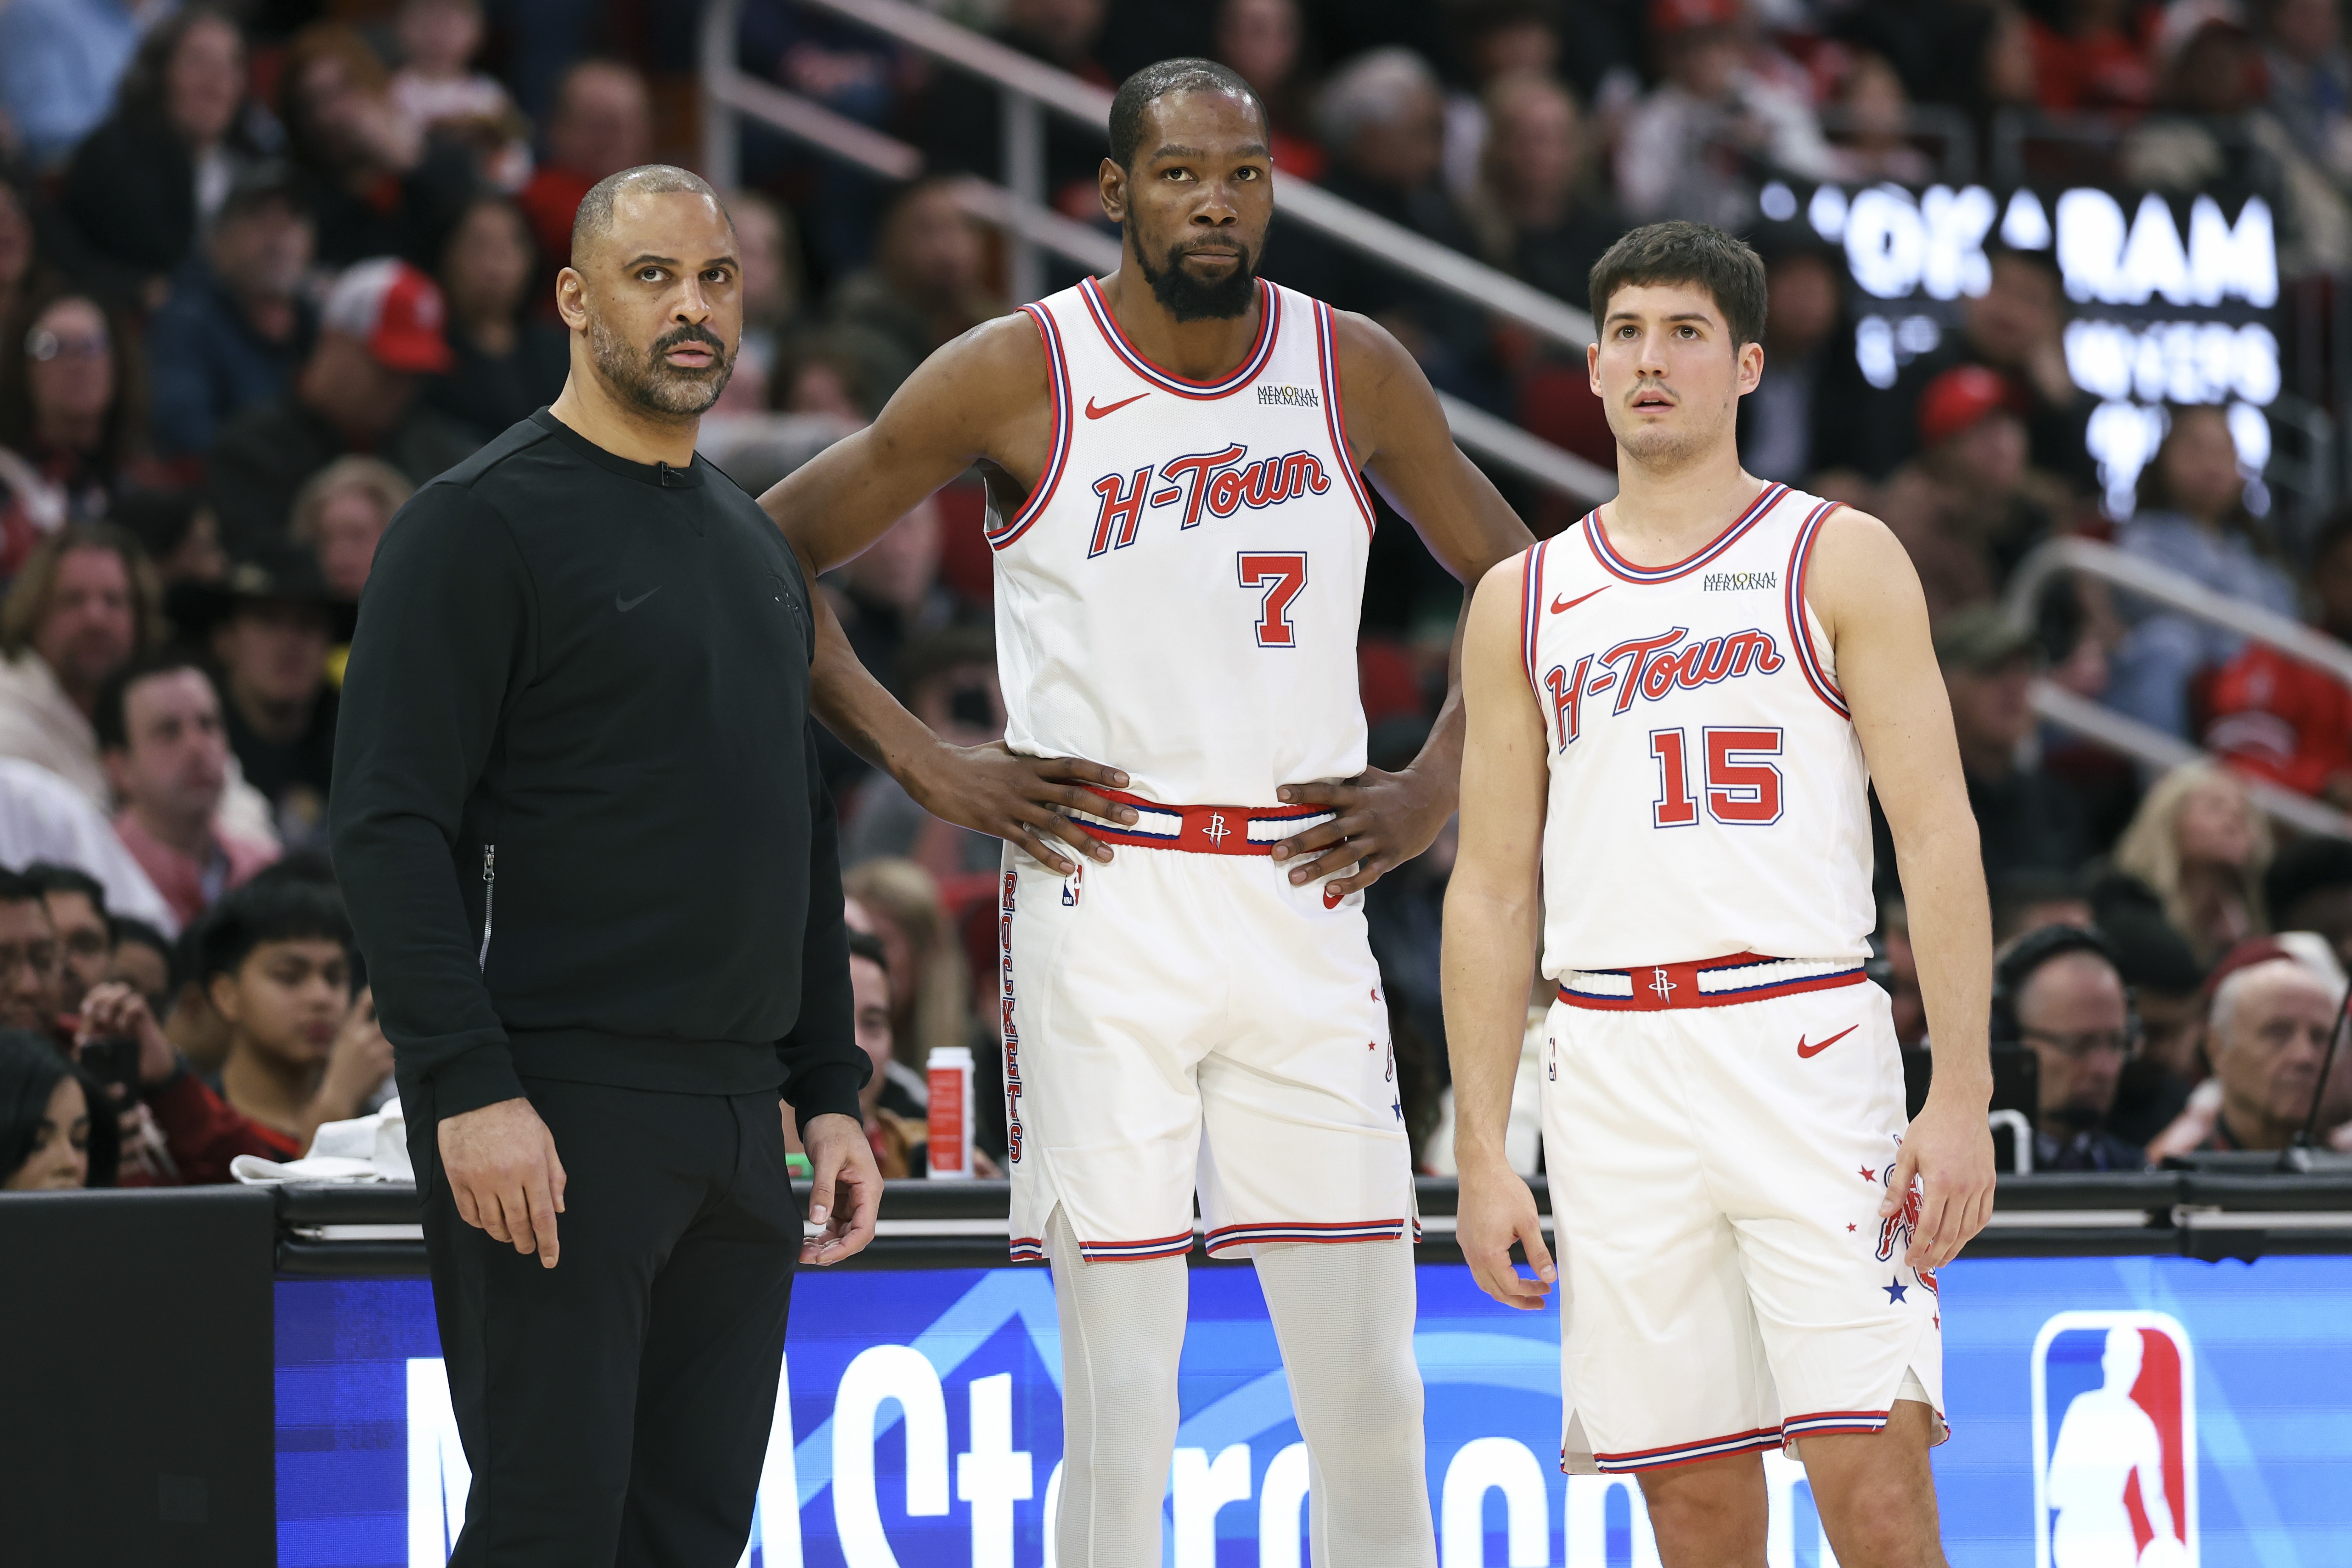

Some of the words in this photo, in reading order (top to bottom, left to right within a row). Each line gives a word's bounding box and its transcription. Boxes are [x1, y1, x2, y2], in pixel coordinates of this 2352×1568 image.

[1258, 385, 1318, 398] MEMORIAL
[1258, 394, 1318, 407] HERMANN
[1087, 443, 1331, 560] H-Town
[1237, 551, 1307, 648] 7
[1703, 580, 1776, 591] HERMANN
[1704, 571, 1777, 583] MEMORIAL
[1545, 626, 1785, 755] H-Town
[1650, 726, 1783, 829] 15
[1063, 896, 1072, 904] NBA
[1000, 871, 1022, 1164] ROCKETS
